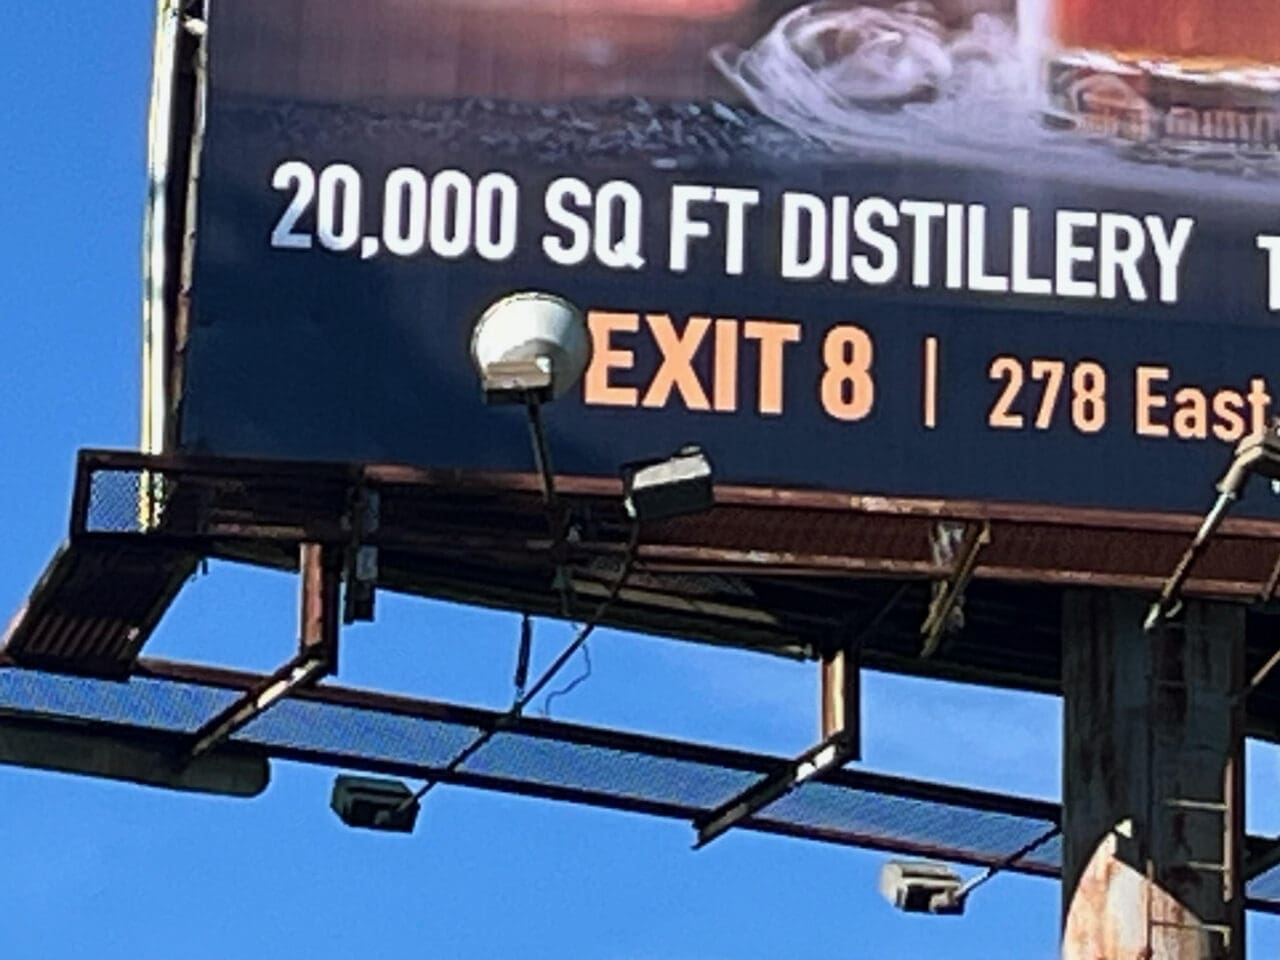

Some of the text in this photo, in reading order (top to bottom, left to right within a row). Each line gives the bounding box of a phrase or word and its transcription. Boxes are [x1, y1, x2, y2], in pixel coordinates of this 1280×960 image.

[271, 160, 1195, 303] 20,000 SQ FT DISTILLERY
[583, 311, 875, 422] EXIT 8
[988, 357, 1107, 433] 278
[1135, 365, 1272, 442] East
